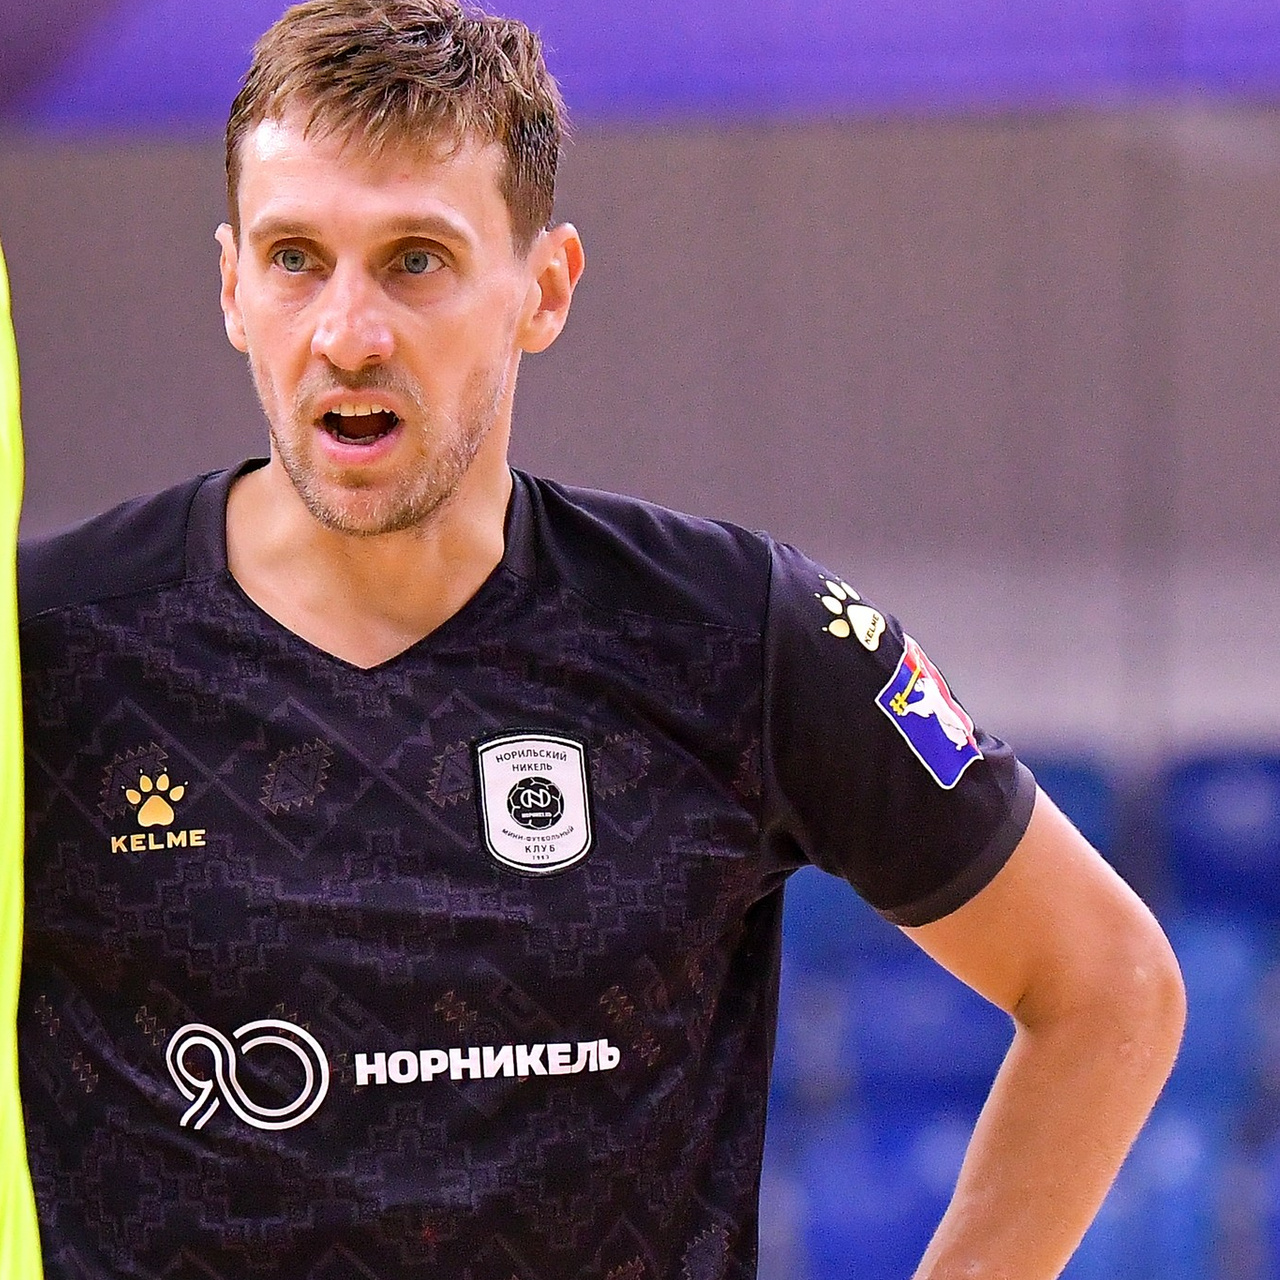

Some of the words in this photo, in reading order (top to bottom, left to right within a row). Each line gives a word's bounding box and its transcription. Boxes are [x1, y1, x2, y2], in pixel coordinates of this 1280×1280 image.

[495, 748, 568, 763] НОРИЛЬСКИЙ
[511, 762, 554, 772] НИКЕЛЬ
[110, 828, 207, 854] KELME
[524, 844, 557, 854] КЛУБ
[354, 1037, 621, 1086] НОРНИКЕЛЬ
